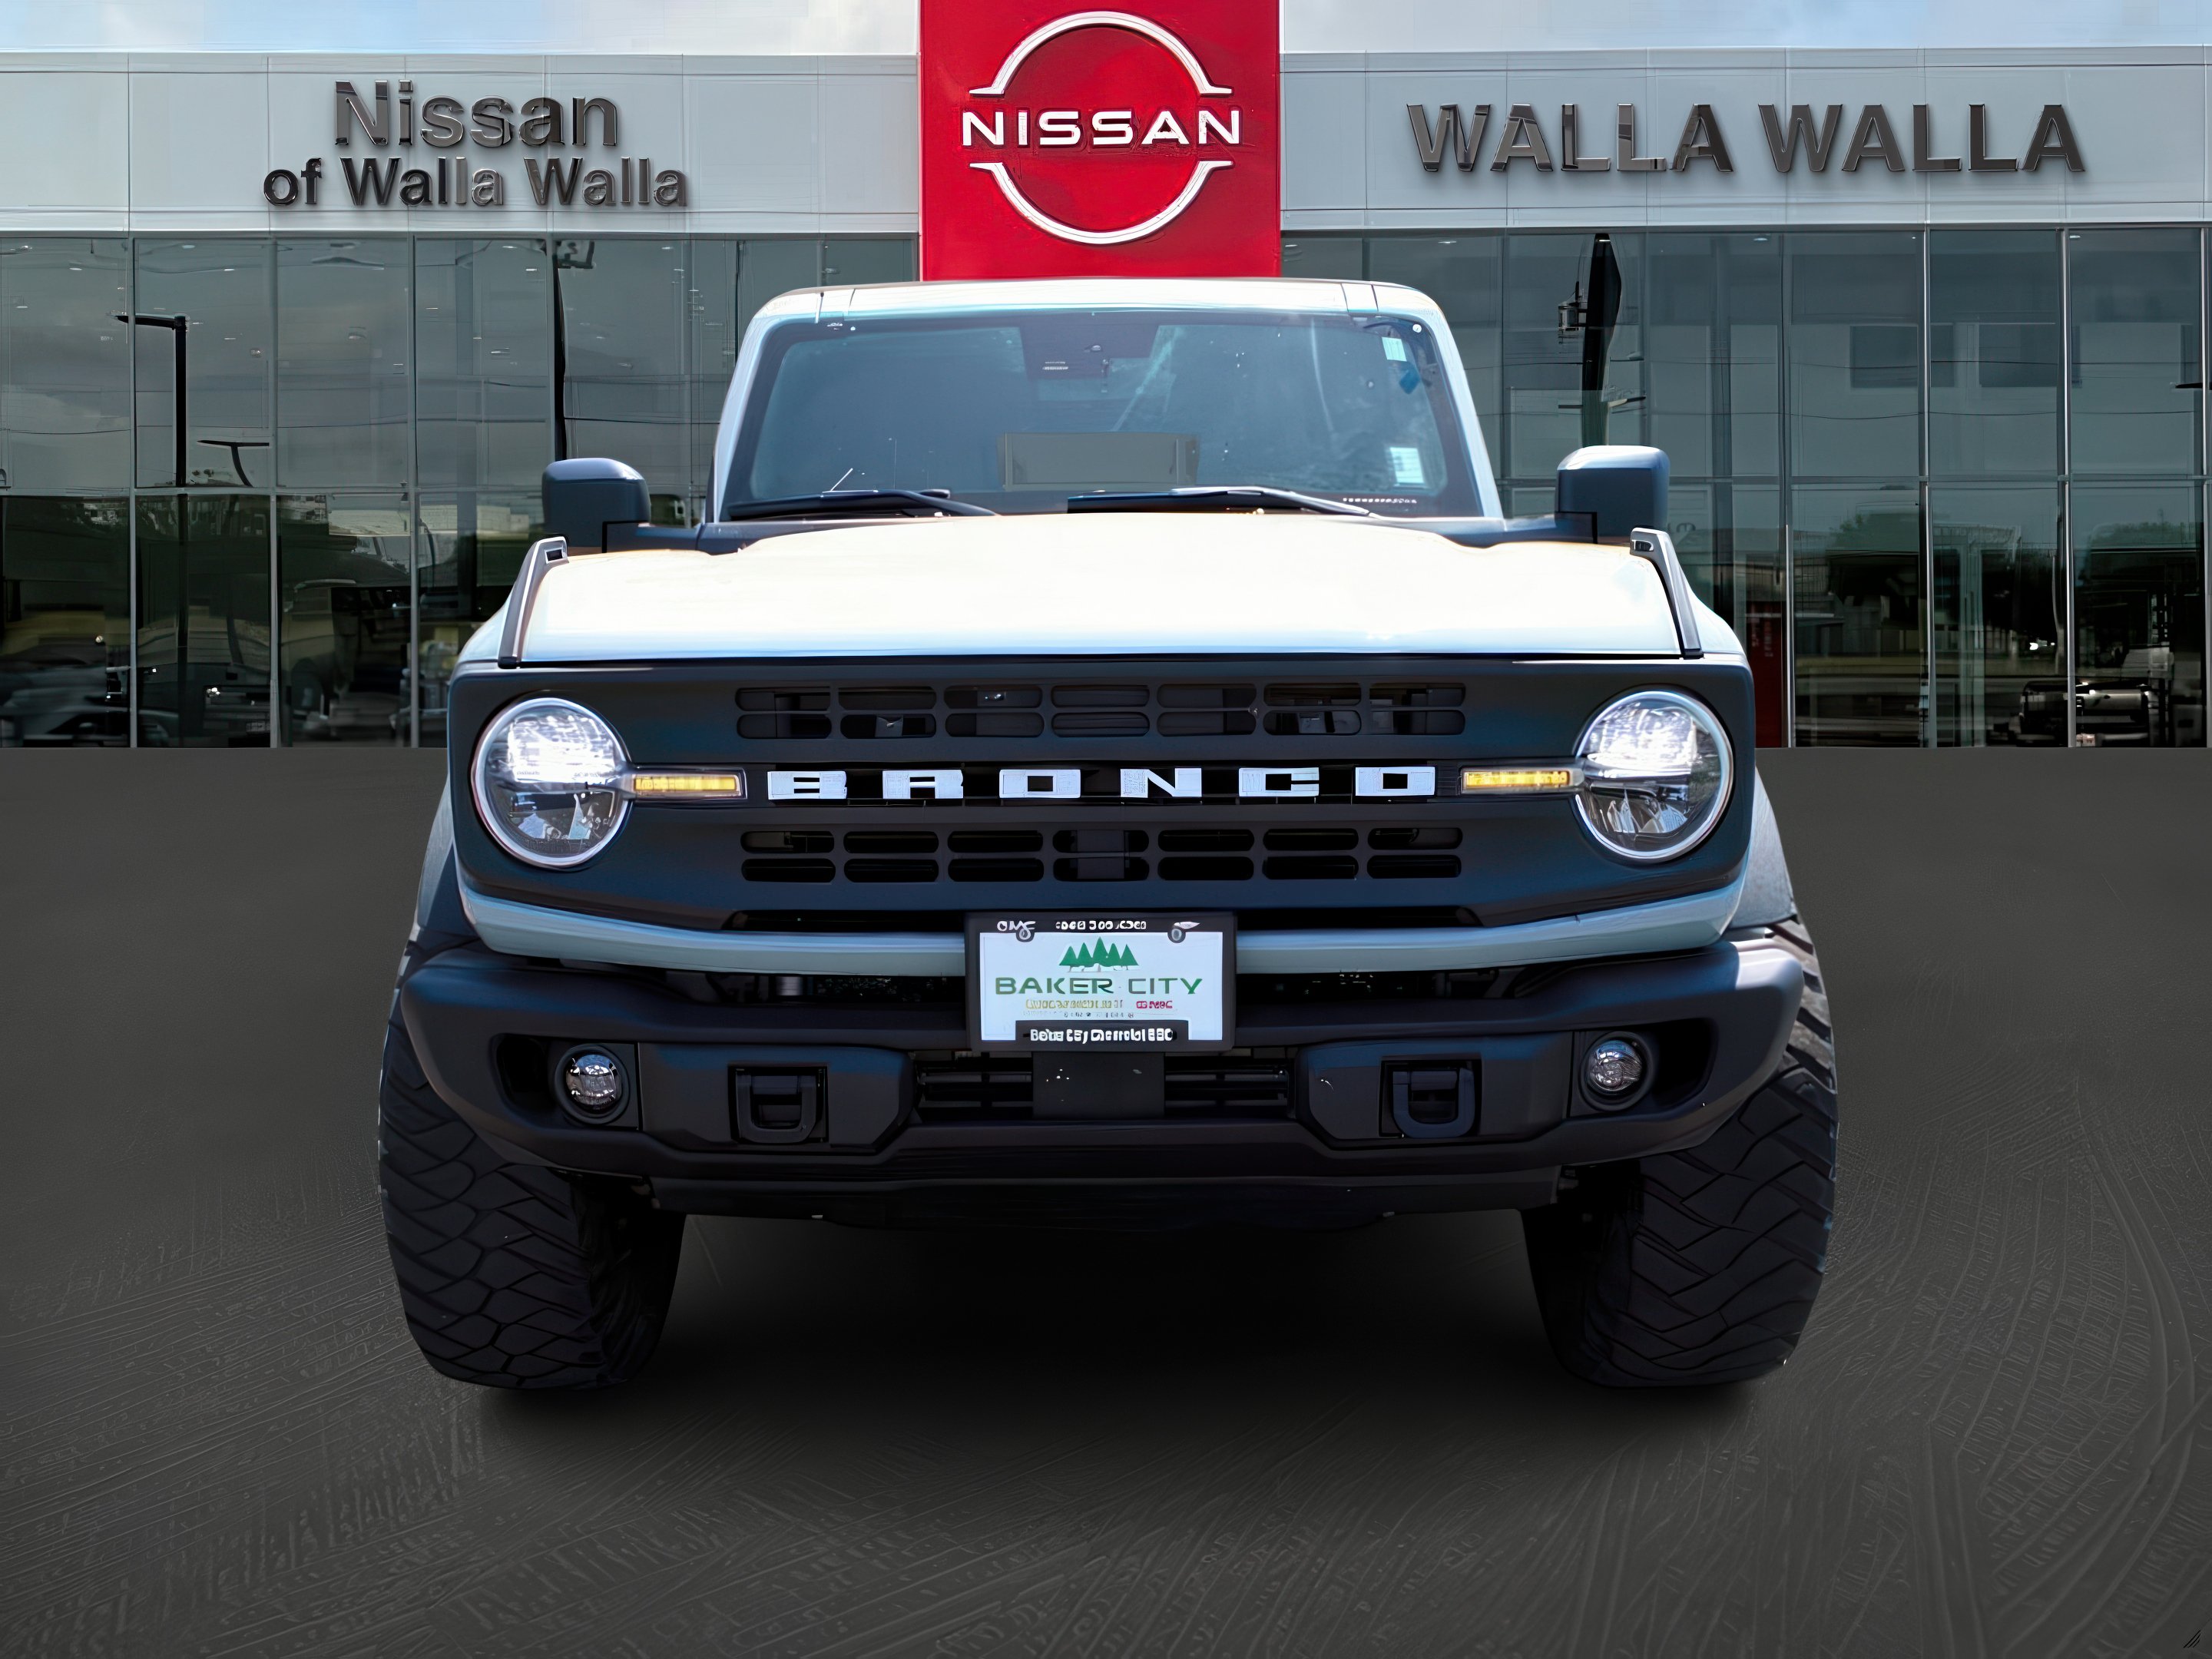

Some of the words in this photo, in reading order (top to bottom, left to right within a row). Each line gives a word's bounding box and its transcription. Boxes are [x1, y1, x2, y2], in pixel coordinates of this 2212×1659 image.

[335, 79, 618, 147] Nissan
[962, 110, 1240, 146] NISSAN
[1406, 103, 1734, 173] WALLA
[1757, 103, 2085, 173] WALLA
[263, 157, 323, 206] of
[339, 156, 504, 206] Walla
[523, 156, 687, 207] Walla
[767, 767, 1435, 799] BRONCO
[995, 977, 1114, 995] BAKER
[1128, 977, 1204, 995] CITY
